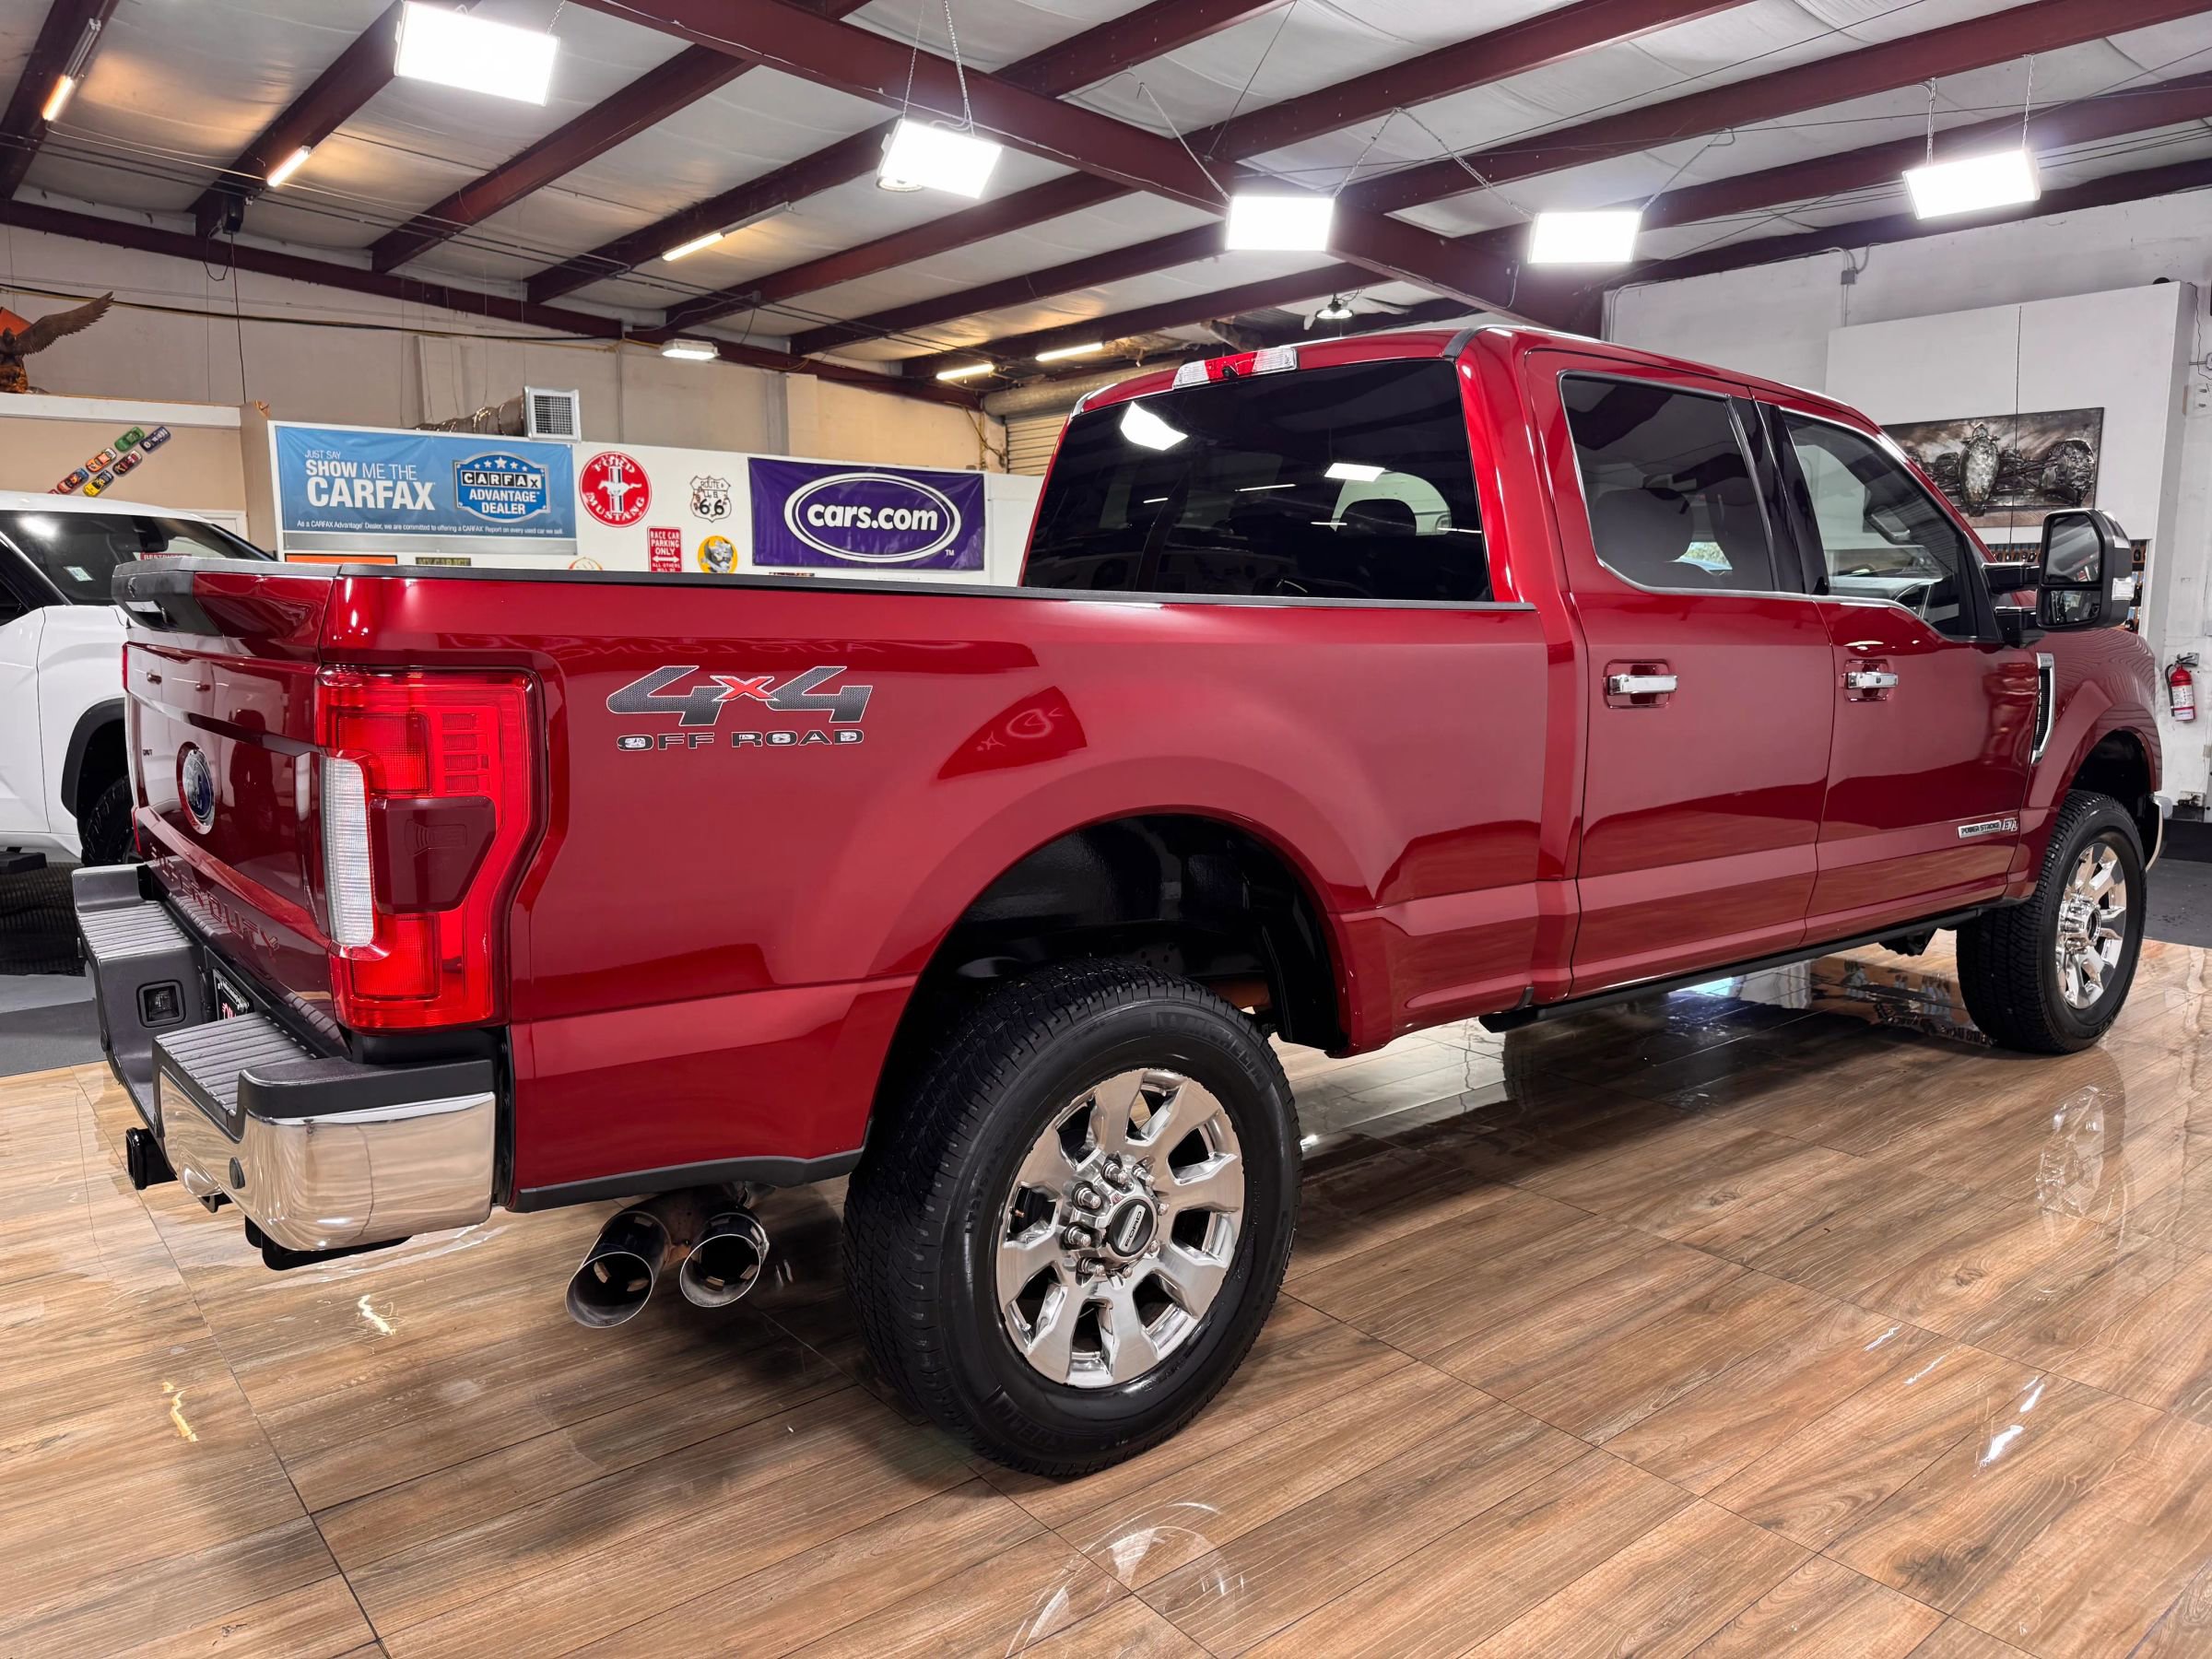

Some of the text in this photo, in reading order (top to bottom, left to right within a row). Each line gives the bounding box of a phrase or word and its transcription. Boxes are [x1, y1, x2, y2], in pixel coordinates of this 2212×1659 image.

[305, 450, 341, 460] JUST SAY
[305, 459, 418, 480] SHOW ME THE
[592, 455, 635, 474] FORD
[464, 472, 538, 488] CARFAX
[700, 480, 720, 488] ROUTE
[307, 477, 436, 511] CARFAX
[481, 501, 526, 514] DEALER
[582, 491, 645, 522] MUSTANG
[699, 499, 724, 515] 66
[806, 503, 938, 531] cars.com
[311, 520, 333, 528] CARFAX
[403, 524, 429, 532] committed
[650, 531, 680, 540] RACE CAR
[651, 539, 680, 548] PARKING
[655, 547, 677, 556] ONLY
[617, 729, 865, 751] OFF ROAD
[206, 889, 280, 959] DUTY
